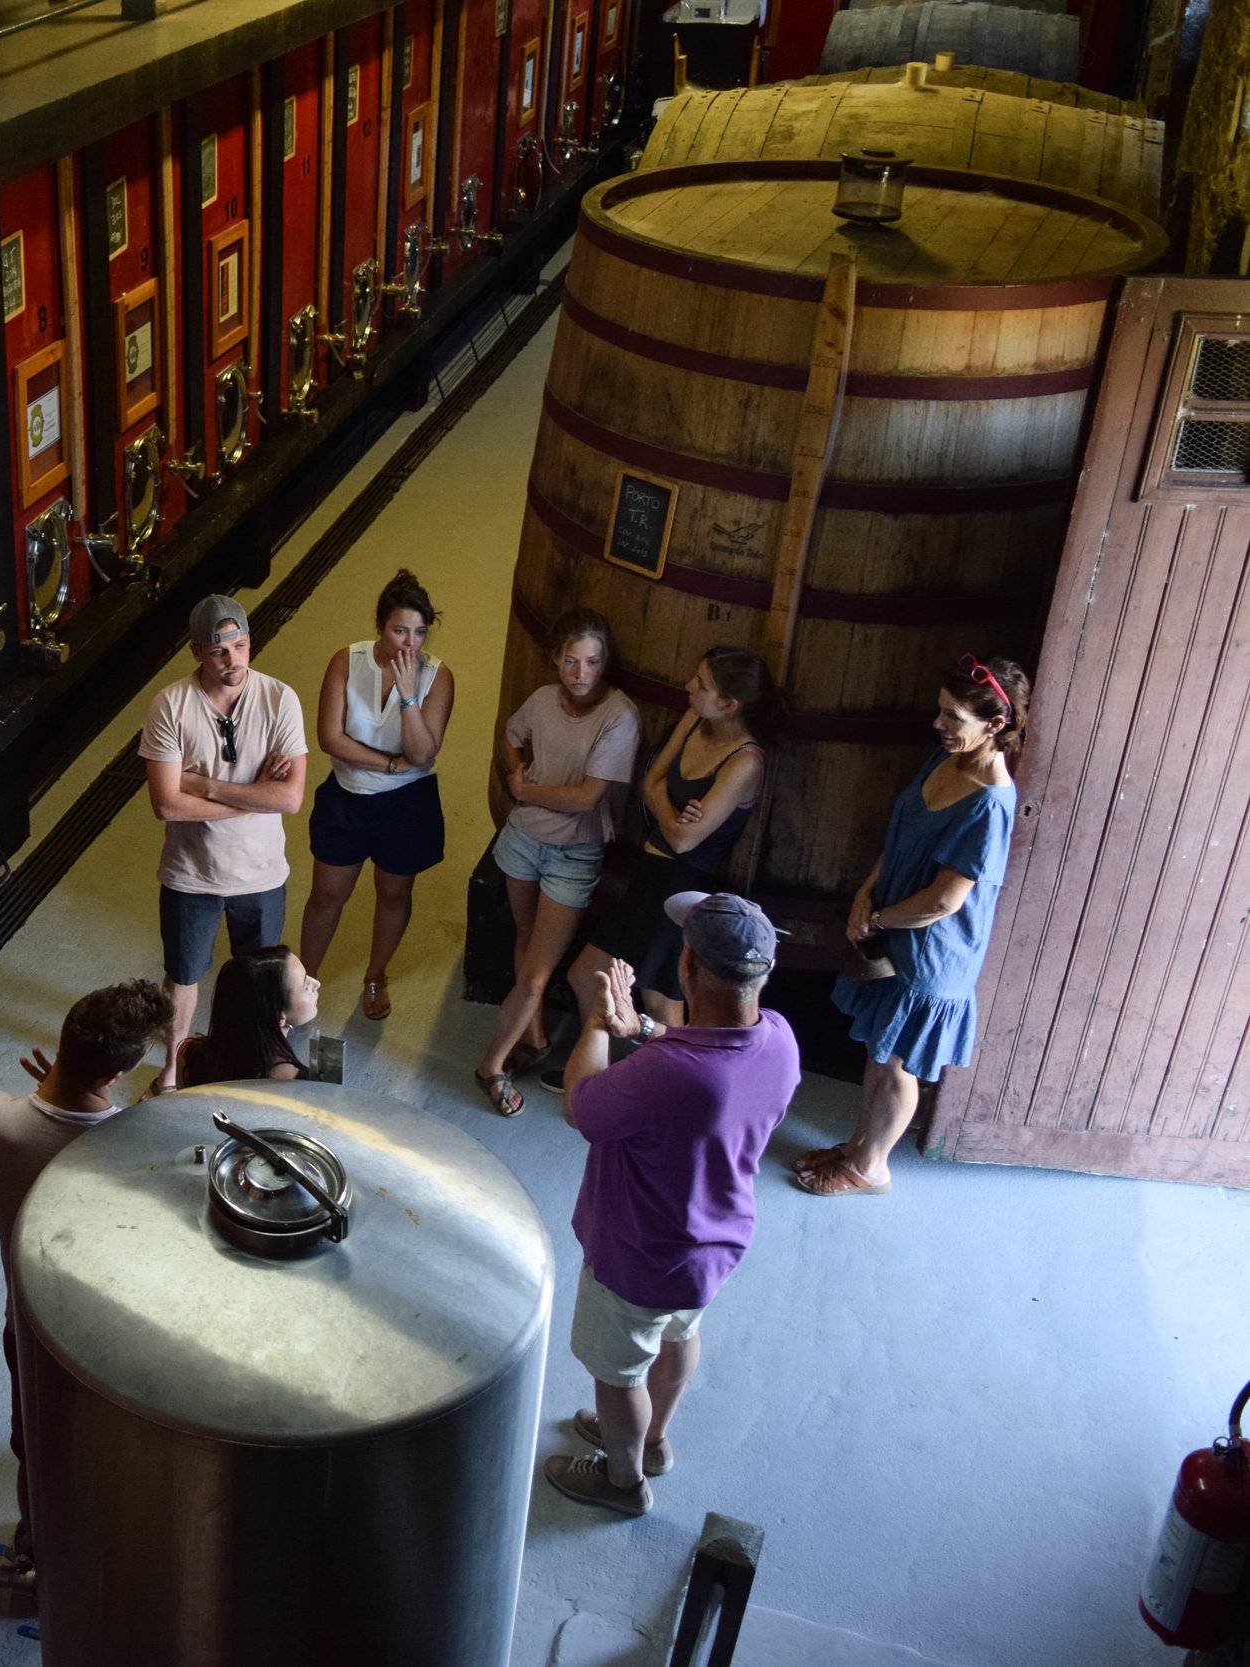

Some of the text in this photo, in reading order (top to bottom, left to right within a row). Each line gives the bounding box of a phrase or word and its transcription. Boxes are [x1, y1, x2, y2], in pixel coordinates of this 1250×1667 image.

[225, 196, 238, 221] 10
[38, 306, 47, 332] 8
[626, 485, 660, 510] PORTO
